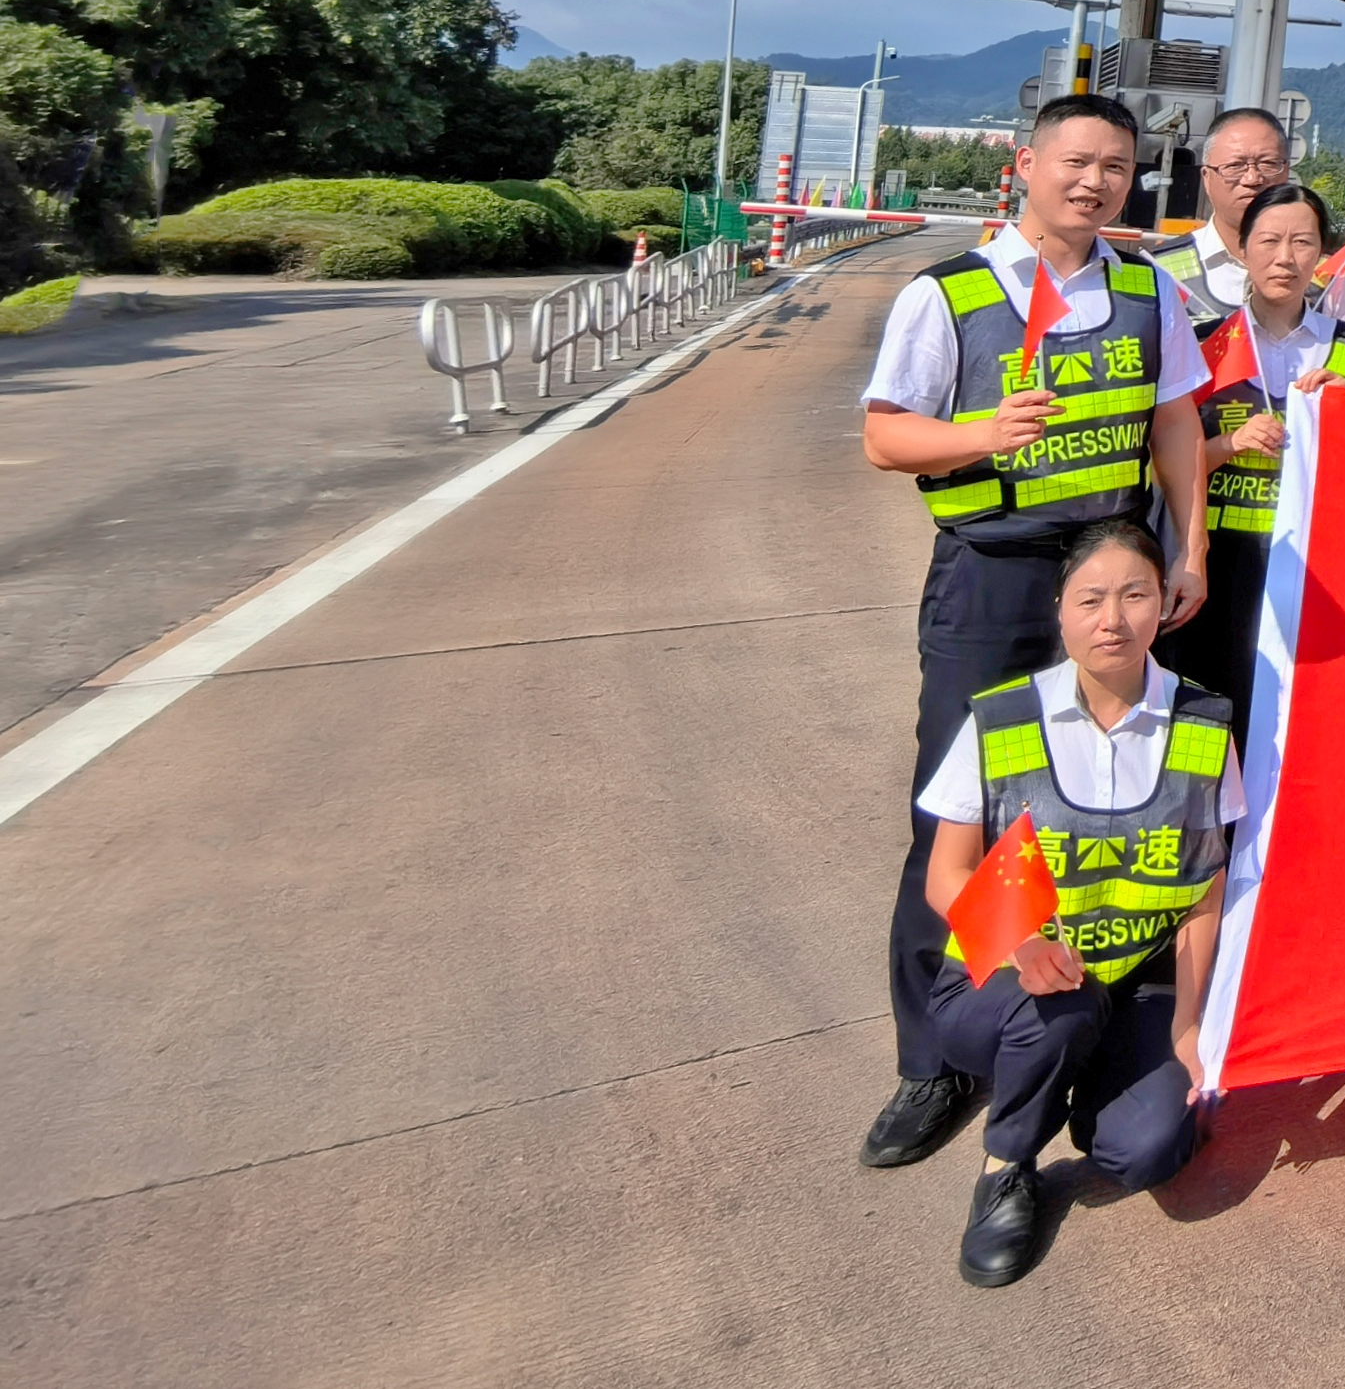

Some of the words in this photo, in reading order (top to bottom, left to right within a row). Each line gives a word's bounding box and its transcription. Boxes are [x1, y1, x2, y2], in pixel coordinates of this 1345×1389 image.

[1101, 335, 1144, 380] 速
[992, 421, 1148, 472] EXPRESSWAY
[1131, 825, 1181, 877] 速
